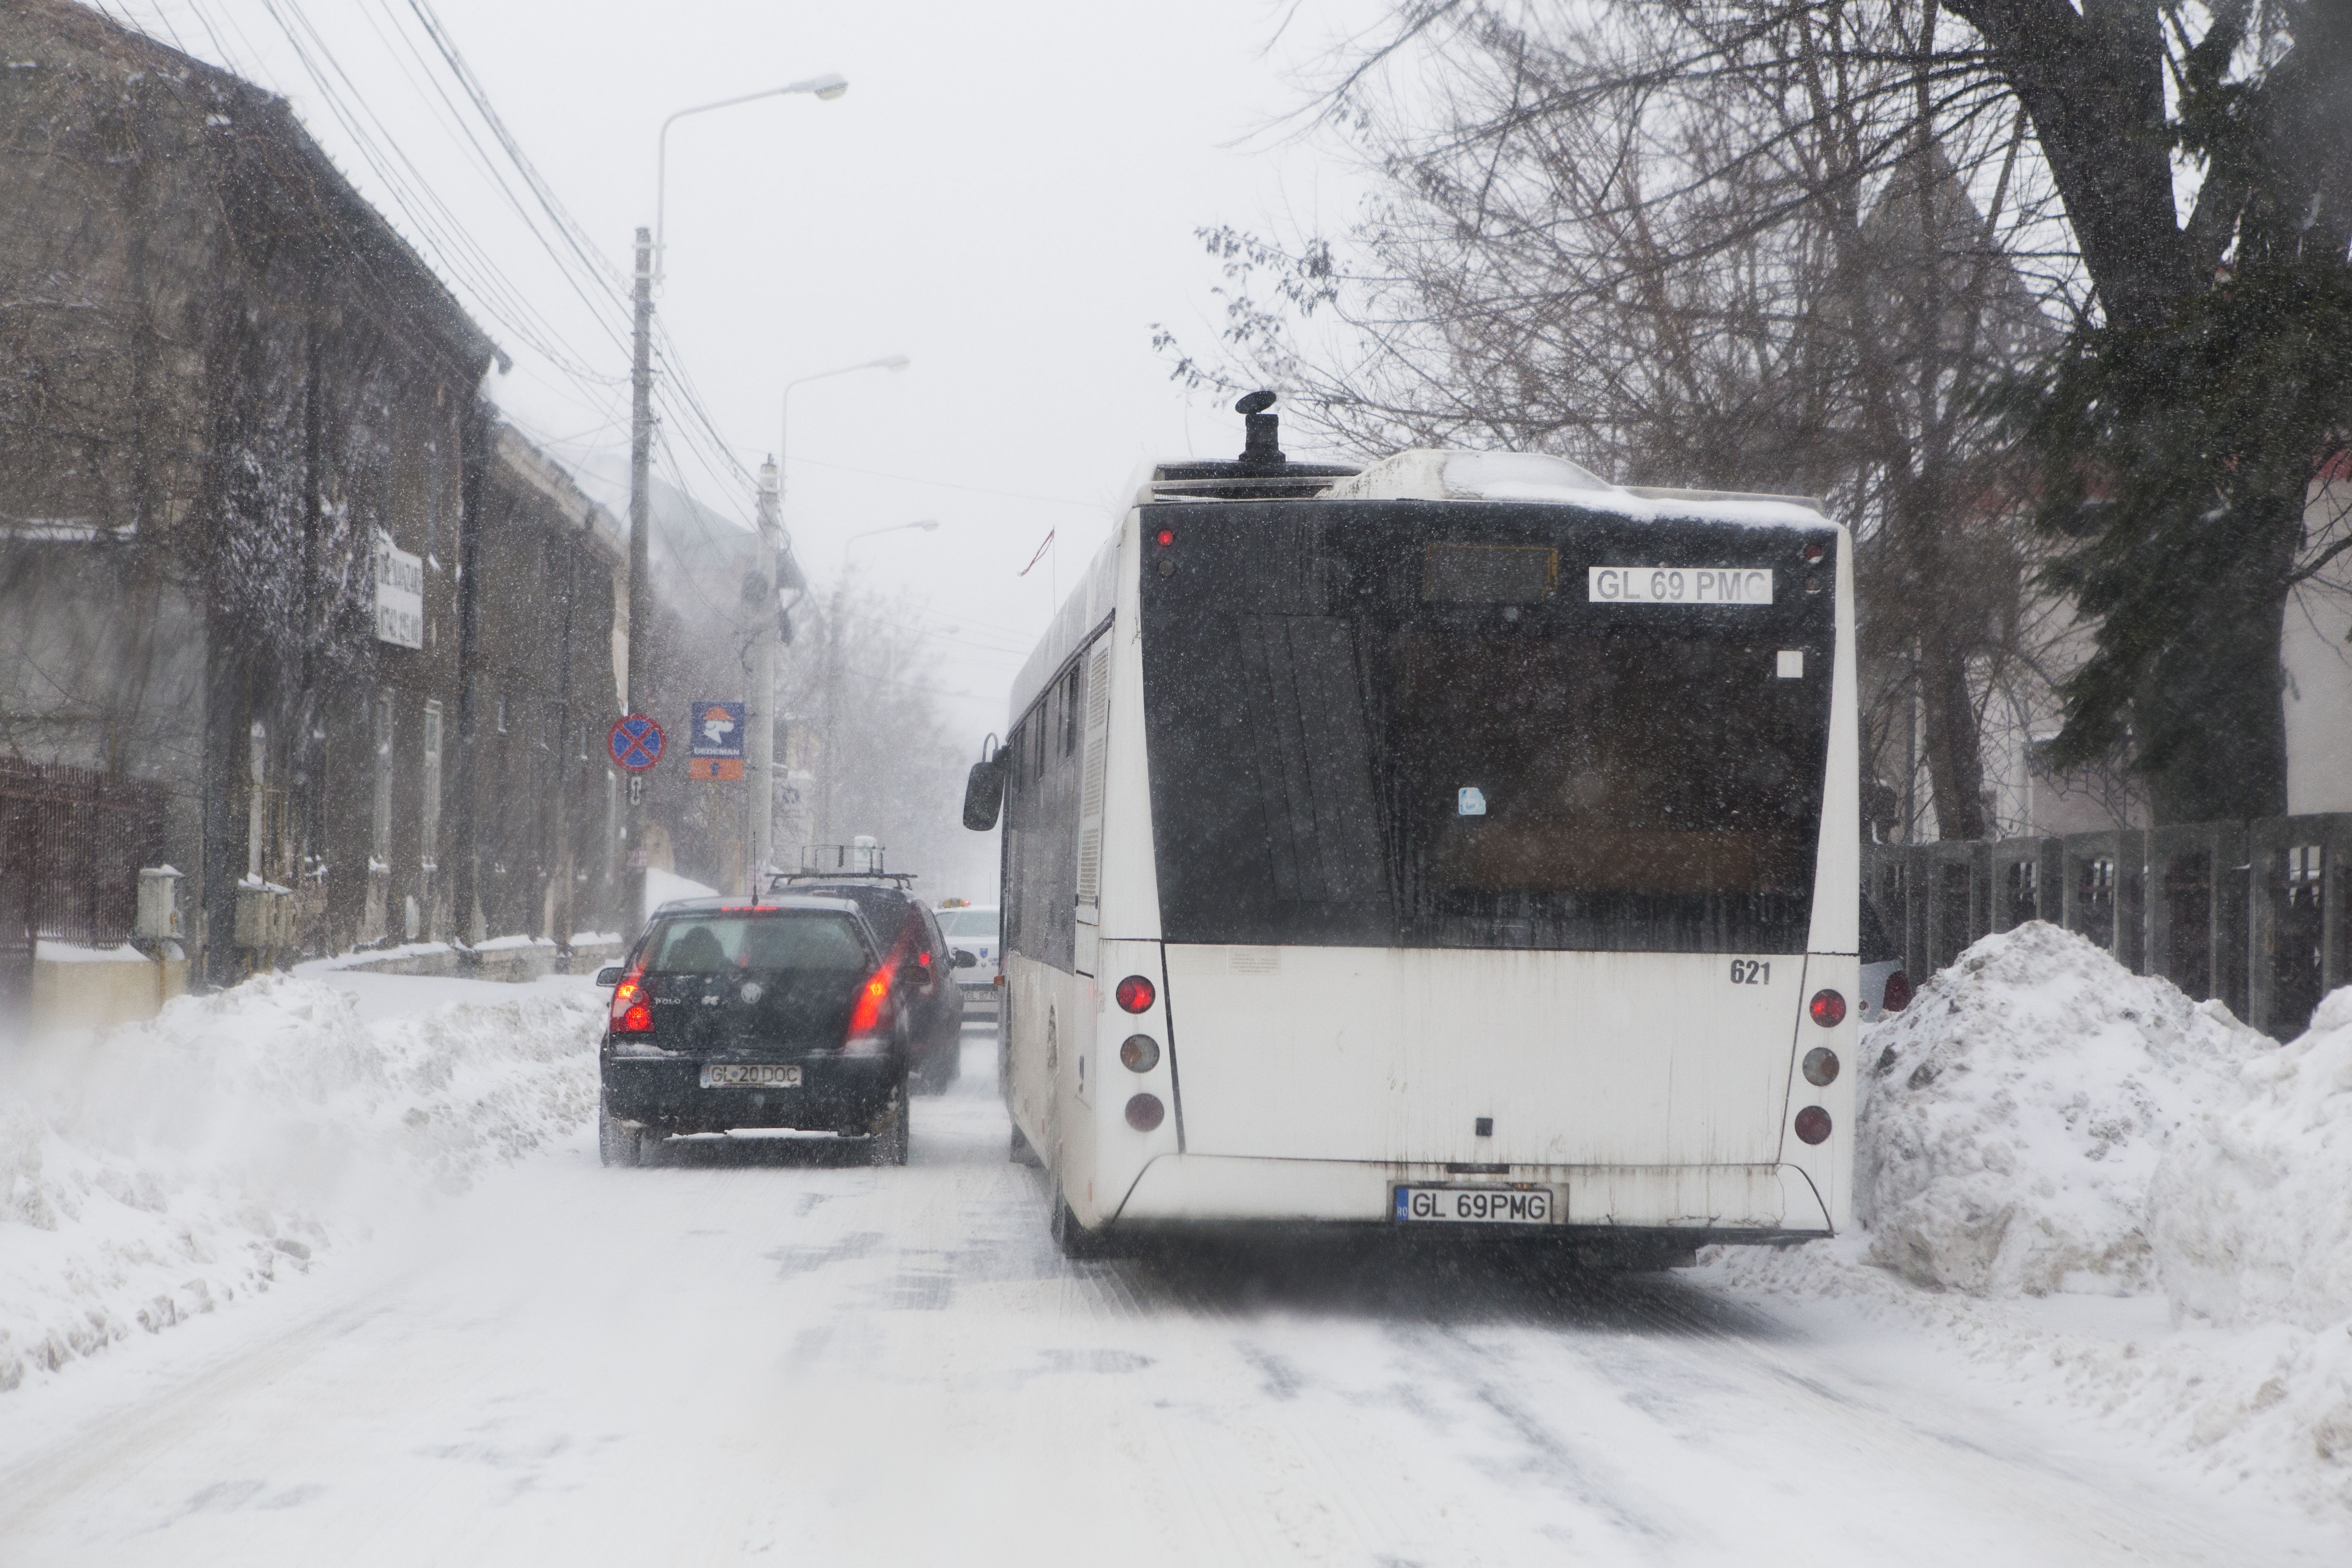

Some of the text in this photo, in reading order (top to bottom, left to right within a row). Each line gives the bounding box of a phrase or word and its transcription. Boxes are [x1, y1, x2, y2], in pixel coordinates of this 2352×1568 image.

[1597, 570, 1766, 600] GL 69 PMG
[694, 747, 740, 756] DEDEMAN
[1730, 959, 1770, 985] 621
[711, 1066, 733, 1082] GL
[1396, 1206, 1408, 1216] RO
[1413, 1193, 1446, 1218] GL
